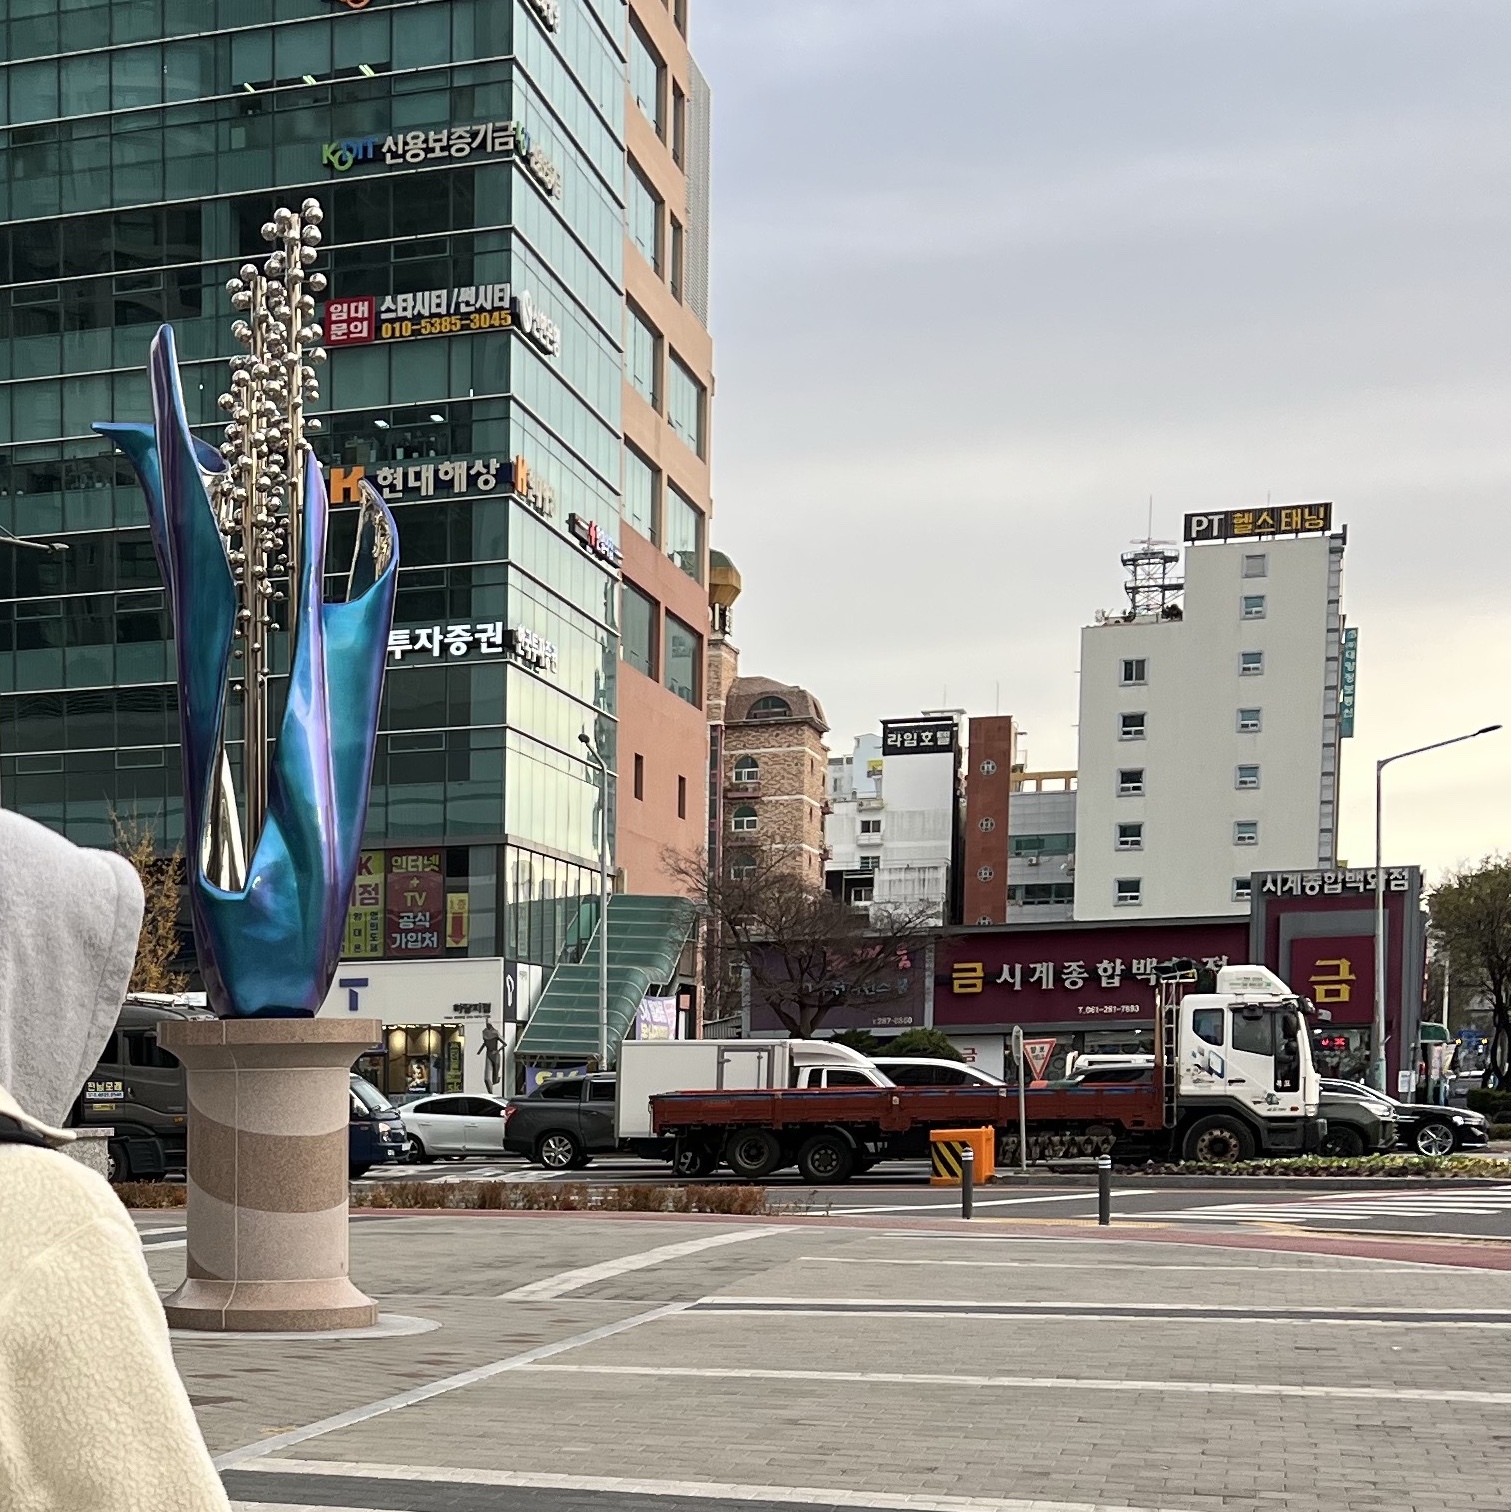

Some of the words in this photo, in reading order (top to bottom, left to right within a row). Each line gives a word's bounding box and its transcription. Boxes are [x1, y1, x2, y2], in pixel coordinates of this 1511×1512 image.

[381, 120, 516, 165] 신용보증기금
[329, 301, 369, 321] 임대
[381, 310, 512, 339] 010-5385-3045
[330, 321, 369, 341] 문의
[376, 458, 500, 499] 현대해상
[1191, 514, 1225, 538] PT
[1232, 506, 1325, 535] 헬스태닝
[387, 621, 503, 660] 투자증권
[391, 853, 440, 873] 인터넷
[403, 891, 427, 907] TV
[399, 912, 430, 929] 공식
[391, 932, 438, 949] 가입처
[952, 962, 984, 993] 금
[1308, 958, 1356, 1003] 금
